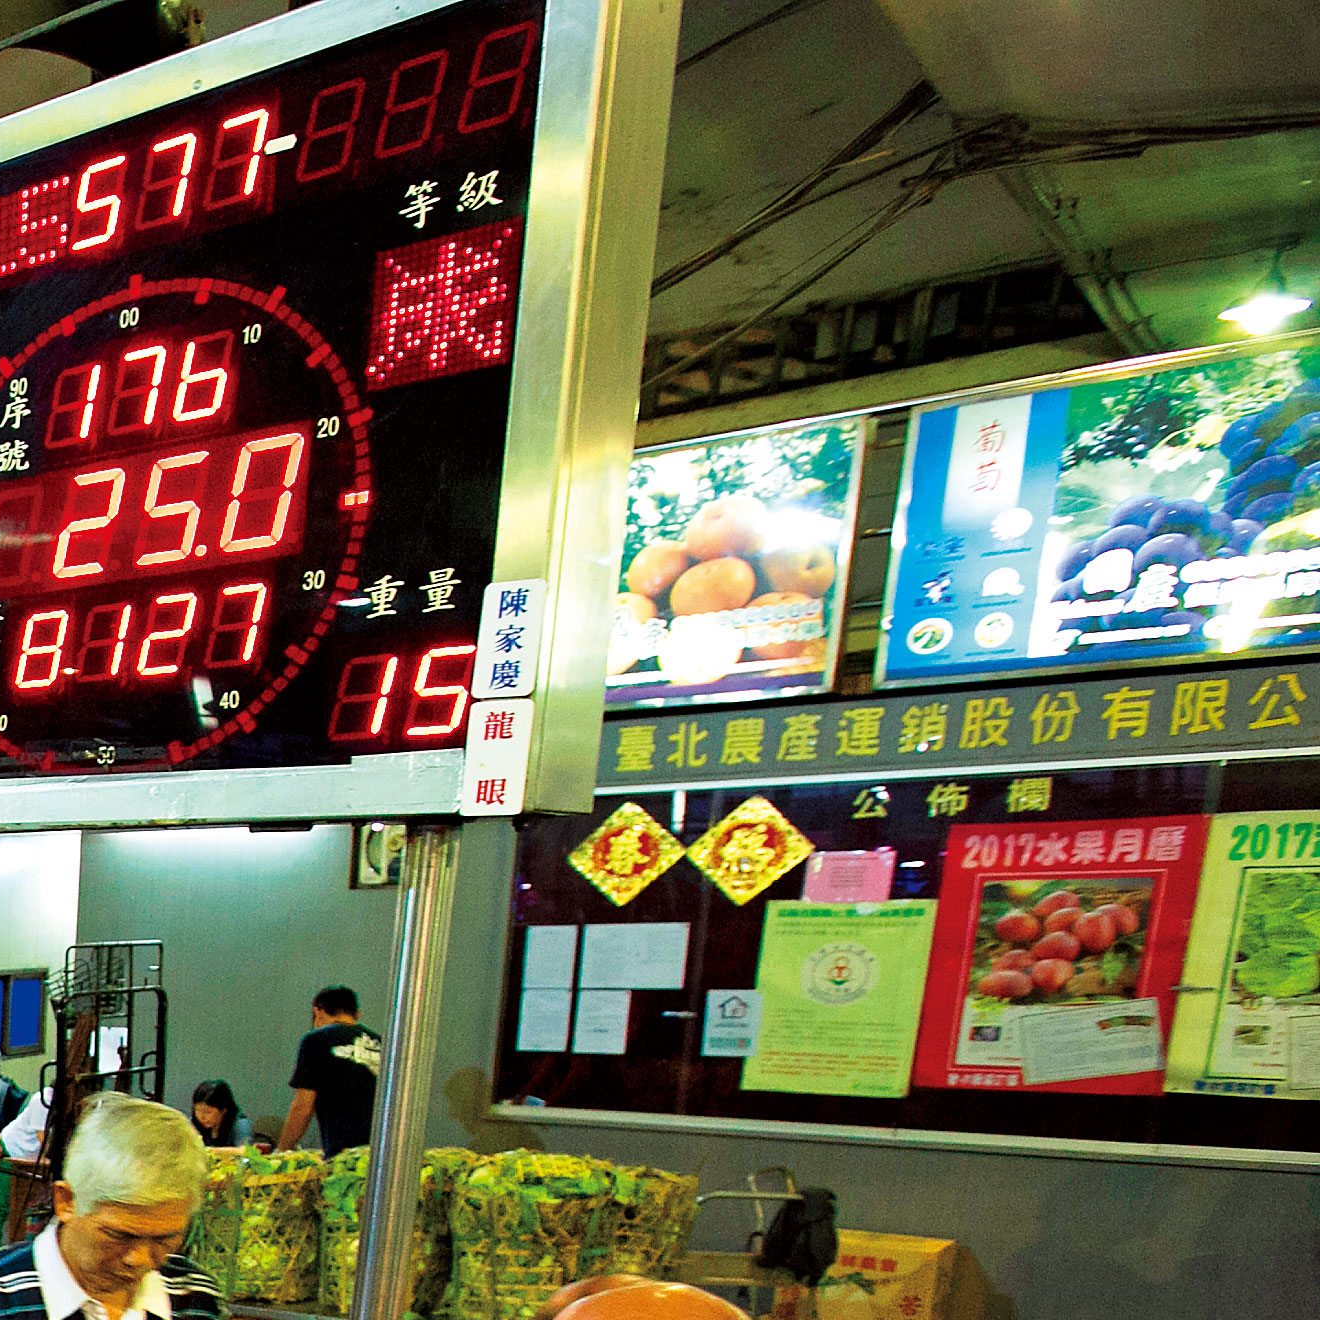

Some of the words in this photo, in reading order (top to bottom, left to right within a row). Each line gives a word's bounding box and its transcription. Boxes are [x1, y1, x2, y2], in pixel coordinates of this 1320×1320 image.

[399, 170, 503, 229] 等級
[119, 307, 140, 328] 00
[242, 324, 262, 344] 10
[9, 377, 28, 397] 90
[80, 342, 228, 438] 176
[316, 416, 340, 438] 20
[969, 420, 1005, 493] 葡萄
[53, 433, 304, 579] 25.0
[302, 569, 326, 591] 30
[363, 567, 462, 619] 重量
[489, 586, 531, 691] 陳家慶
[219, 690, 241, 710] 40
[370, 645, 477, 735] 15
[614, 673, 1308, 773] 臺北農產運銷股份有限公
[96, 746, 116, 765] 50
[475, 711, 516, 806] 龍眼
[852, 776, 1052, 821] 公佈欄
[1229, 822, 1320, 862] 2017
